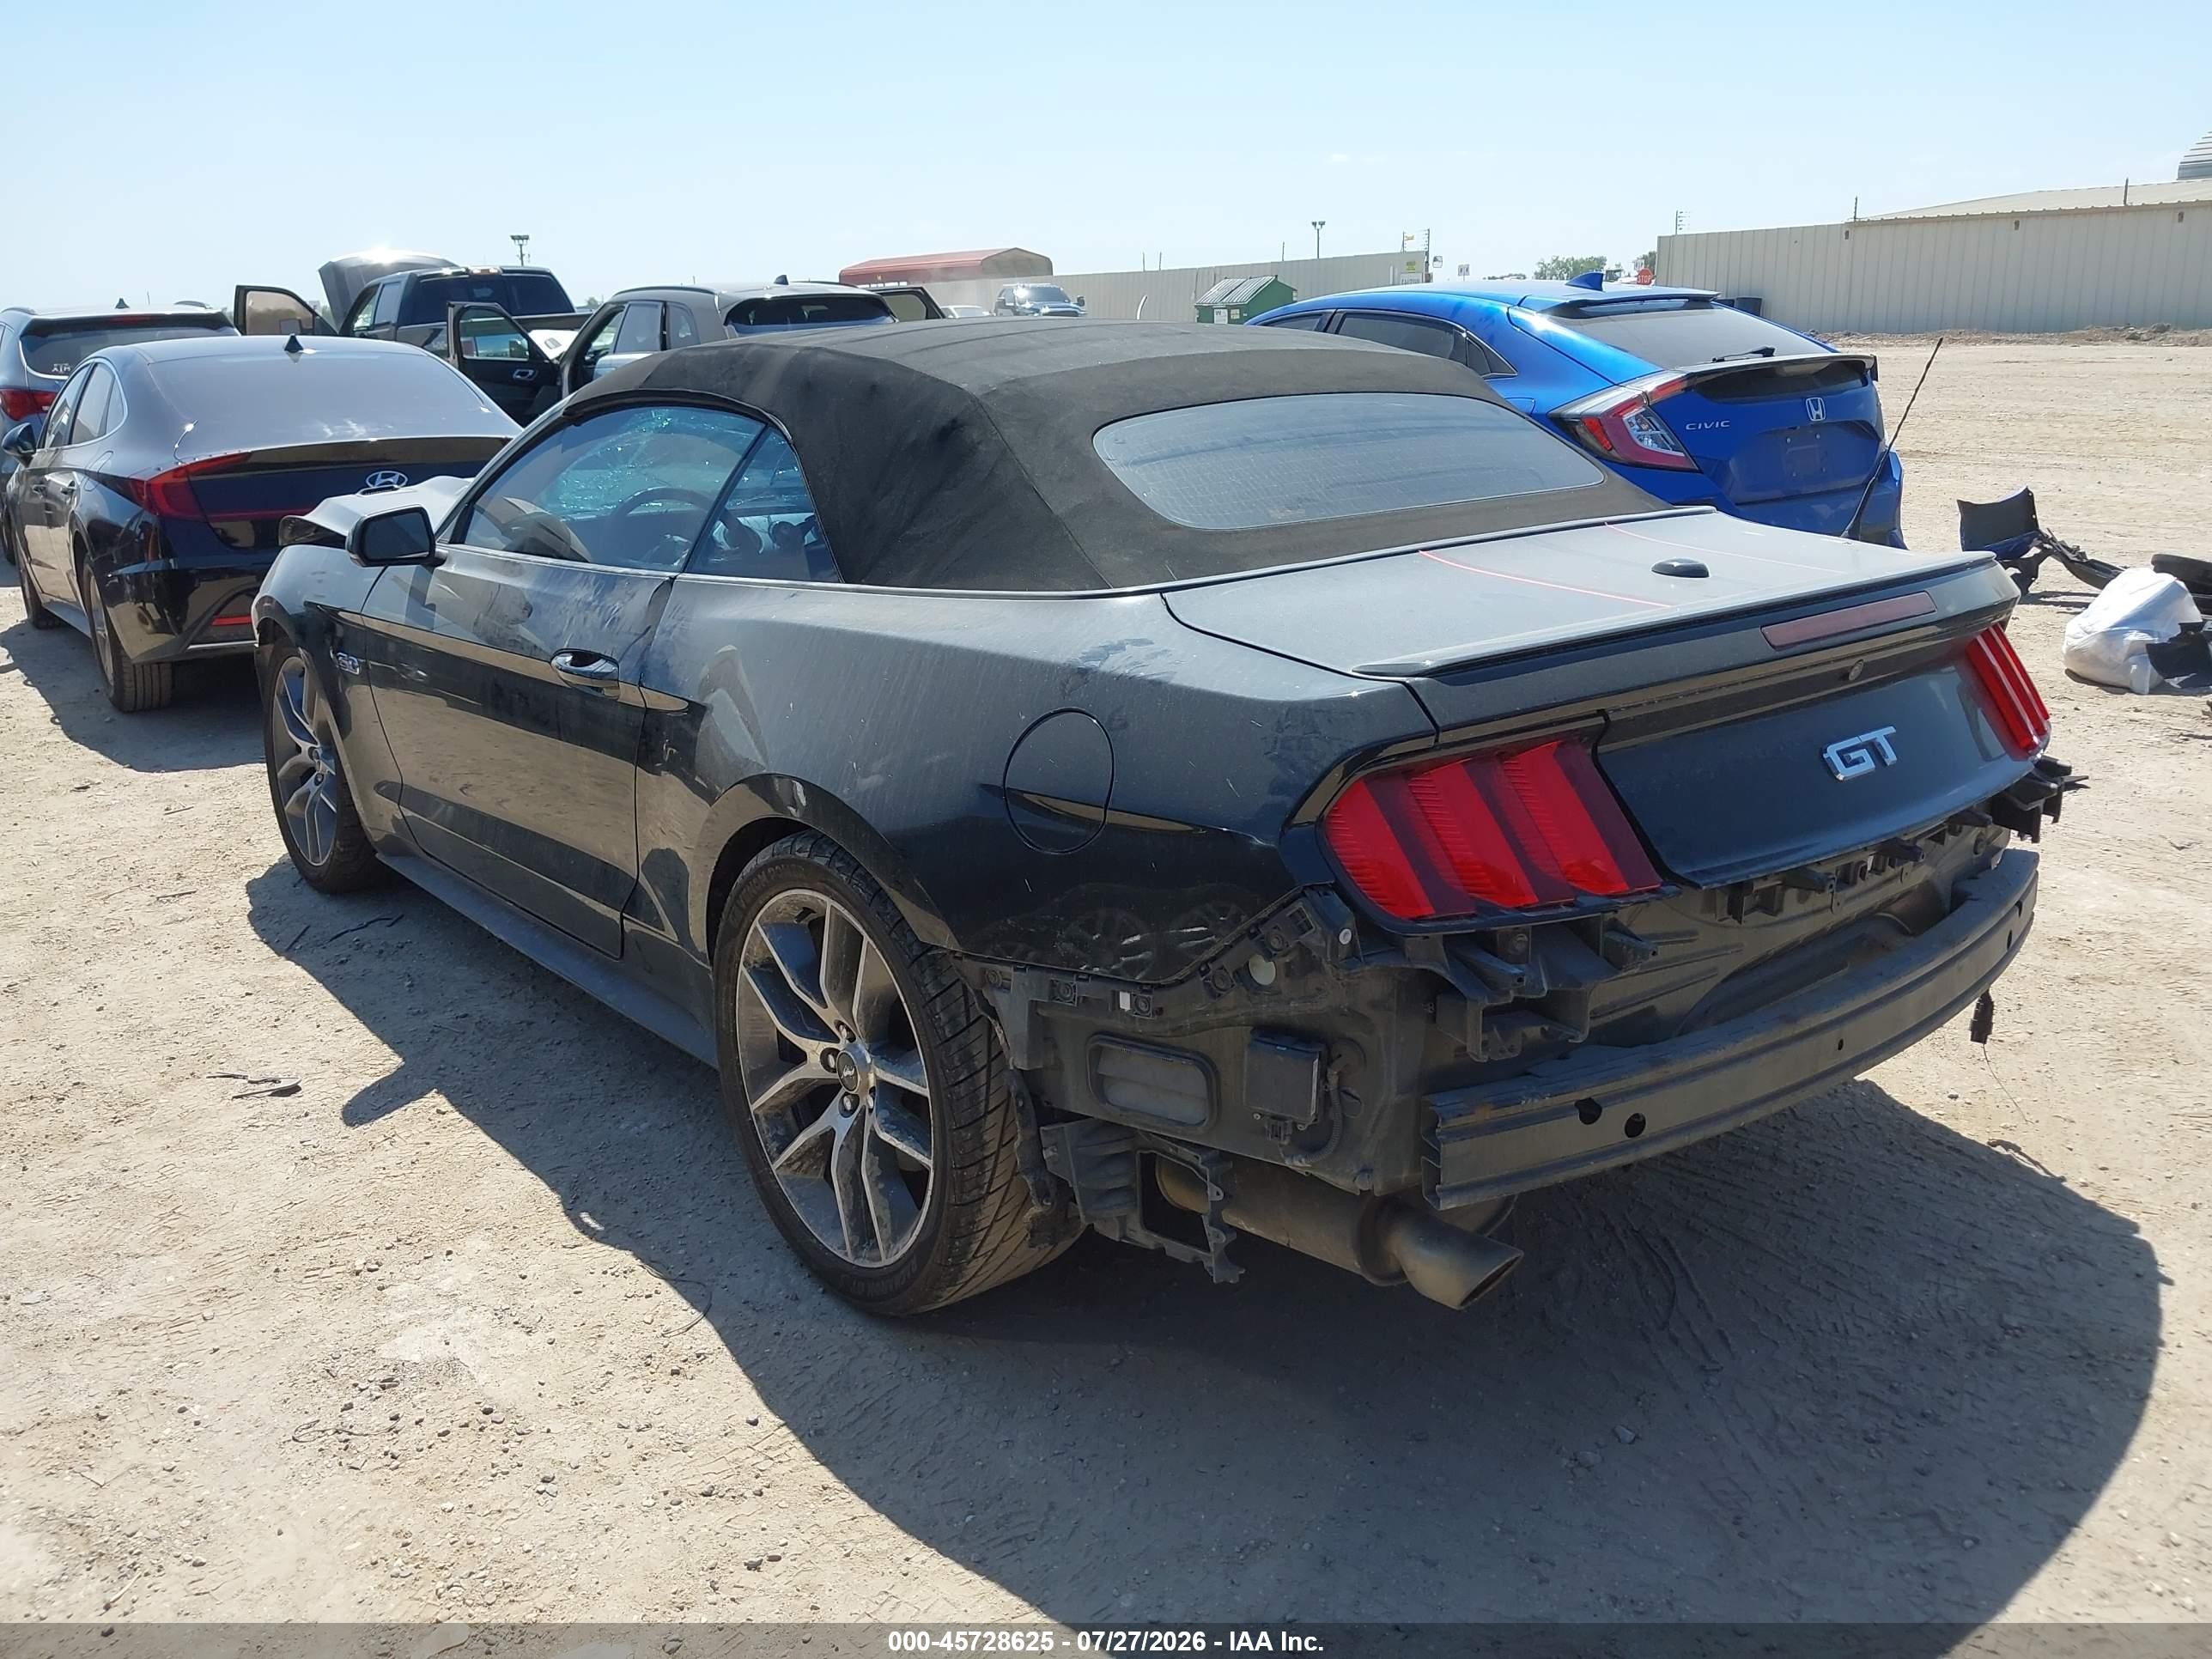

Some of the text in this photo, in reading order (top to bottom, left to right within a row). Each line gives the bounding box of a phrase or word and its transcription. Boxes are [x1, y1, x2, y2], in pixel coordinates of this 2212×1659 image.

[1638, 275, 1650, 283] STOP
[1686, 420, 1730, 430] CIVIC
[1822, 726, 1897, 781] GT
